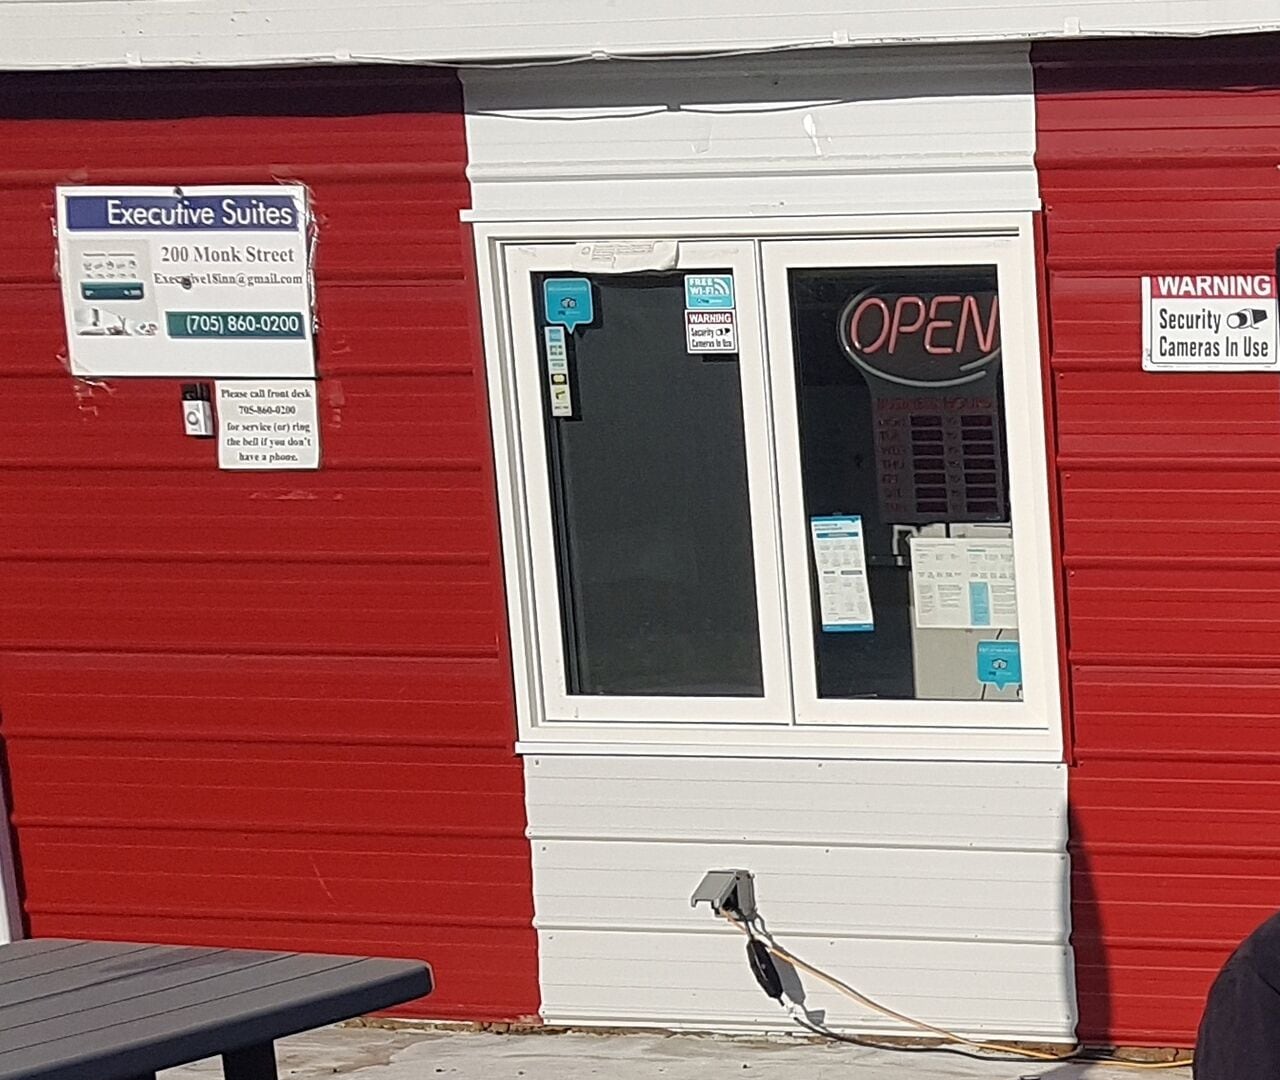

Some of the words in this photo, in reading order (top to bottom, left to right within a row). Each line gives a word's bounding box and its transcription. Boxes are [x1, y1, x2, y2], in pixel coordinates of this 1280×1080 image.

[107, 199, 215, 226] Executive
[222, 198, 293, 226] Suites
[161, 246, 189, 262] 200
[194, 246, 243, 263] Monk
[246, 246, 295, 263] Street
[154, 272, 303, 287] Execuive18inn@gmail.com
[689, 278, 714, 287] FREE
[1157, 275, 1272, 297] WARNING
[186, 314, 224, 334] (705)
[228, 314, 299, 332] 860-0200
[689, 313, 732, 324] WARNING
[851, 295, 999, 354] OPEN
[1159, 308, 1222, 334] Security
[1159, 335, 1220, 357] Cameras
[1225, 336, 1238, 357] In
[1243, 336, 1269, 357] Use
[221, 389, 248, 398] Please
[249, 389, 265, 398] call
[267, 389, 289, 398] front
[291, 389, 311, 398] desk
[238, 405, 296, 415] 705-860-0200
[227, 422, 239, 431] for
[242, 422, 272, 431] service
[273, 422, 290, 432] (or)
[292, 422, 311, 433] ring
[226, 437, 240, 446] the
[242, 437, 259, 446] bell
[261, 437, 267, 446] if
[269, 439, 285, 448] you
[288, 437, 311, 446] don't
[239, 452, 259, 461] have
